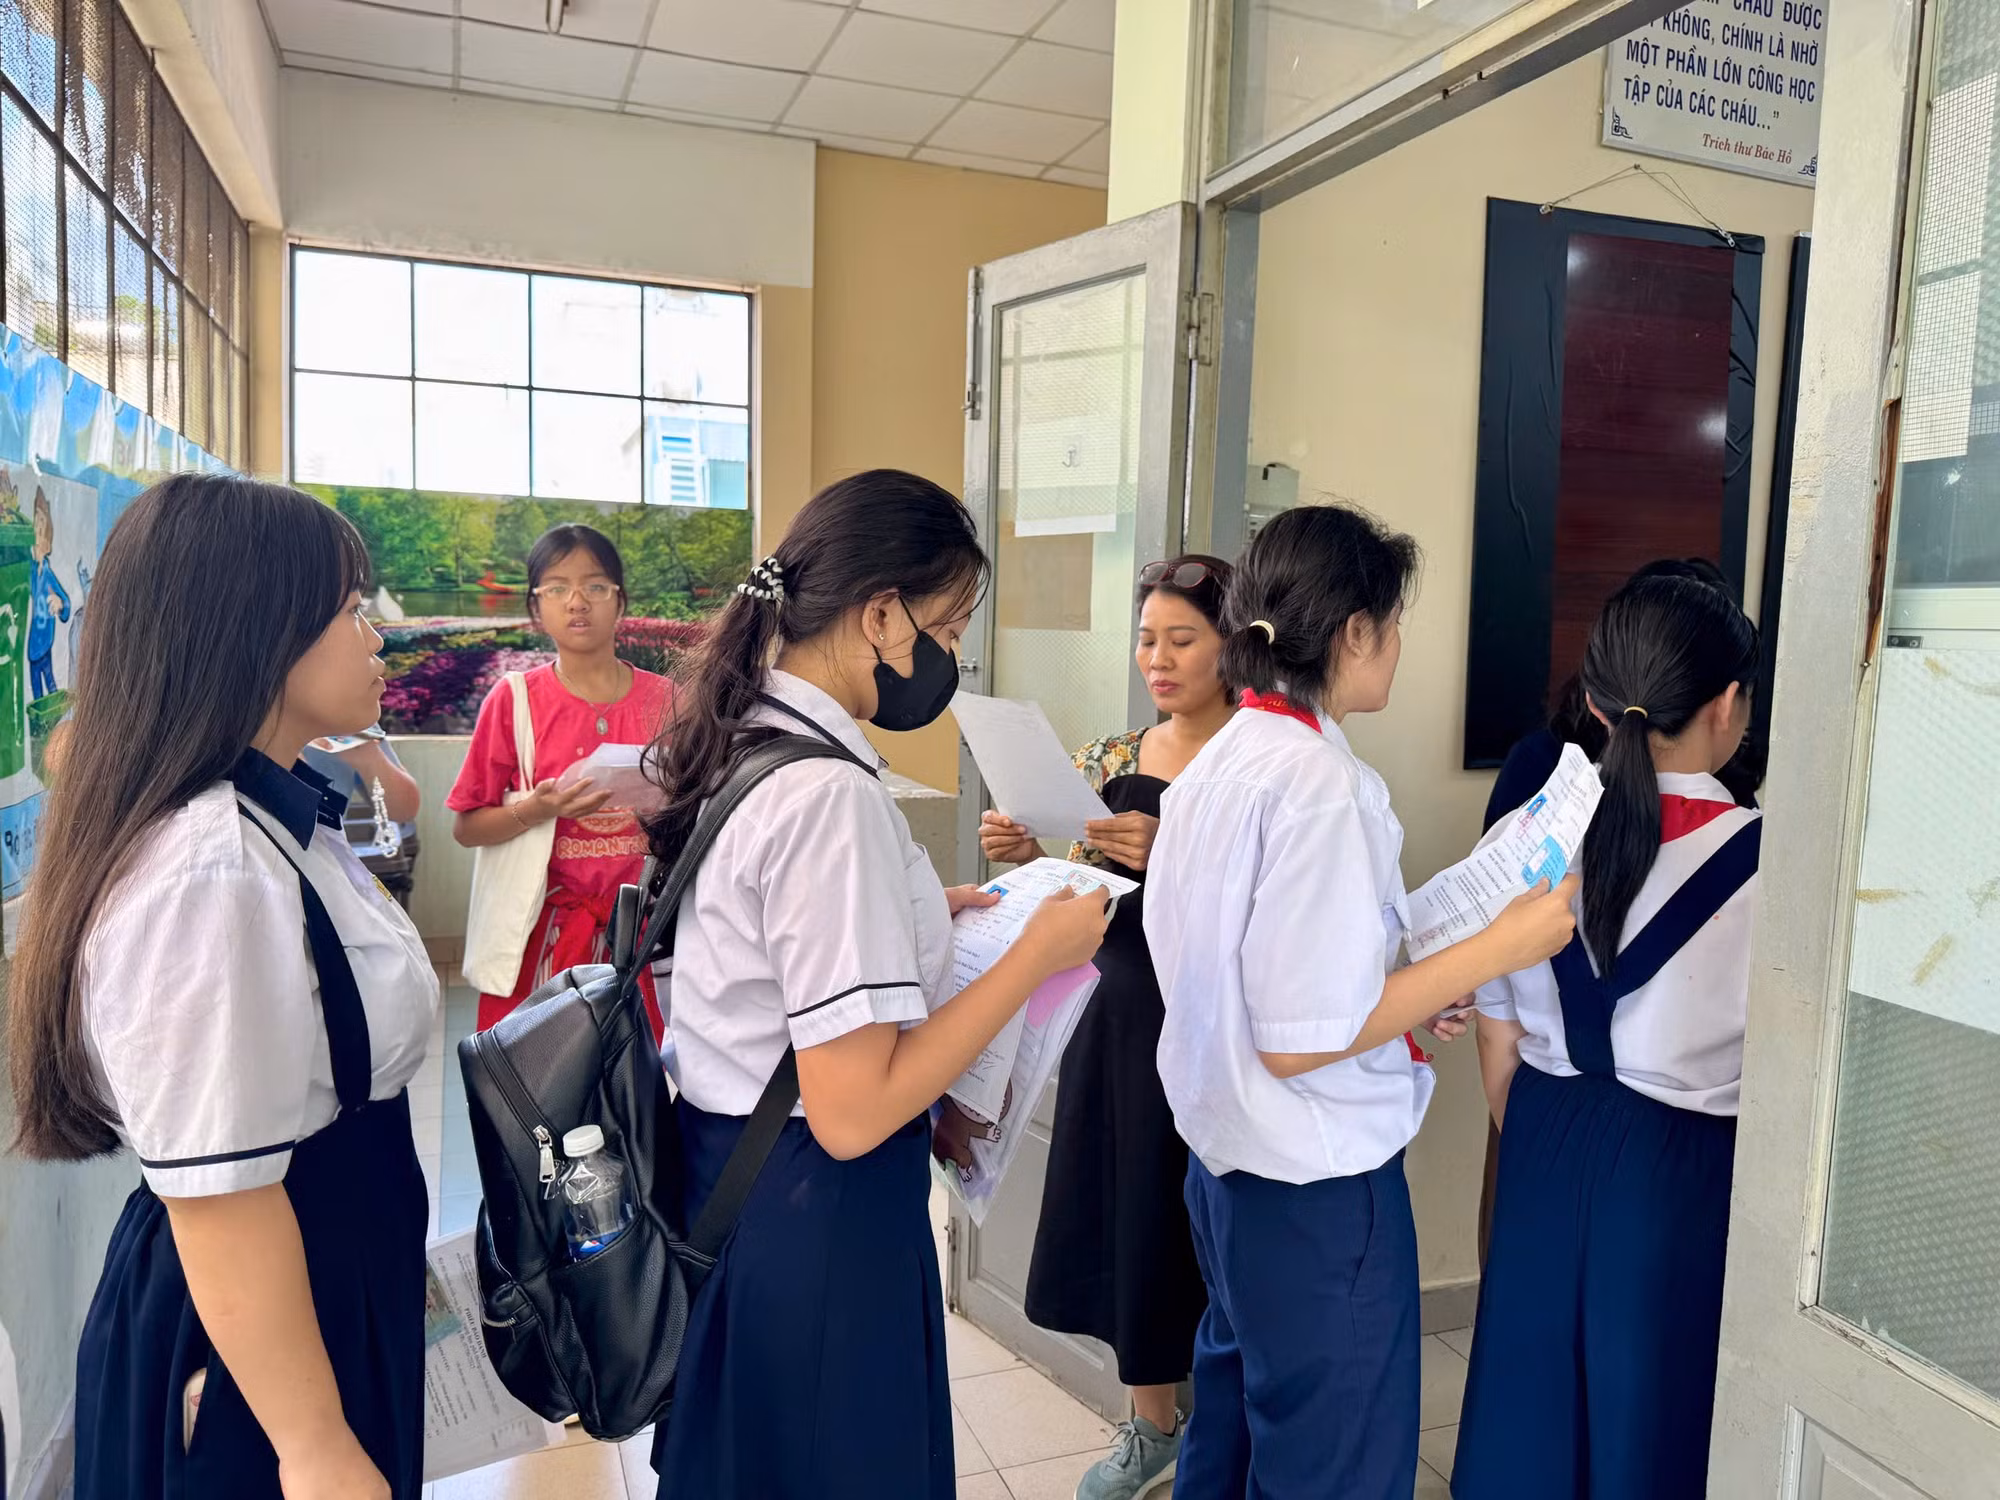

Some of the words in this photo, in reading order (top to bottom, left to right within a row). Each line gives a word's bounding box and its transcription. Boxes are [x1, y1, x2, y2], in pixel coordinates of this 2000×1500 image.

[1663, 9, 1715, 45] KHÔNG,
[1722, 22, 1763, 53] CHÍNH
[1769, 32, 1784, 59] LÀ
[1790, 39, 1818, 66] NHỜ
[1783, 1, 1822, 31] ĐƯỢC
[1626, 37, 1660, 69] MỘT
[1666, 45, 1707, 77] PHẦN
[1713, 57, 1741, 86] LỚN
[1749, 65, 1783, 95] CÔNG
[1789, 77, 1815, 105] HỌC
[1624, 74, 1651, 106] TẬP
[1656, 79, 1683, 111] CỦA
[1689, 89, 1715, 118] CÁC
[1734, 140, 1753, 157] thư
[1754, 144, 1775, 162] Bác
[1777, 148, 1792, 165] Hồ
